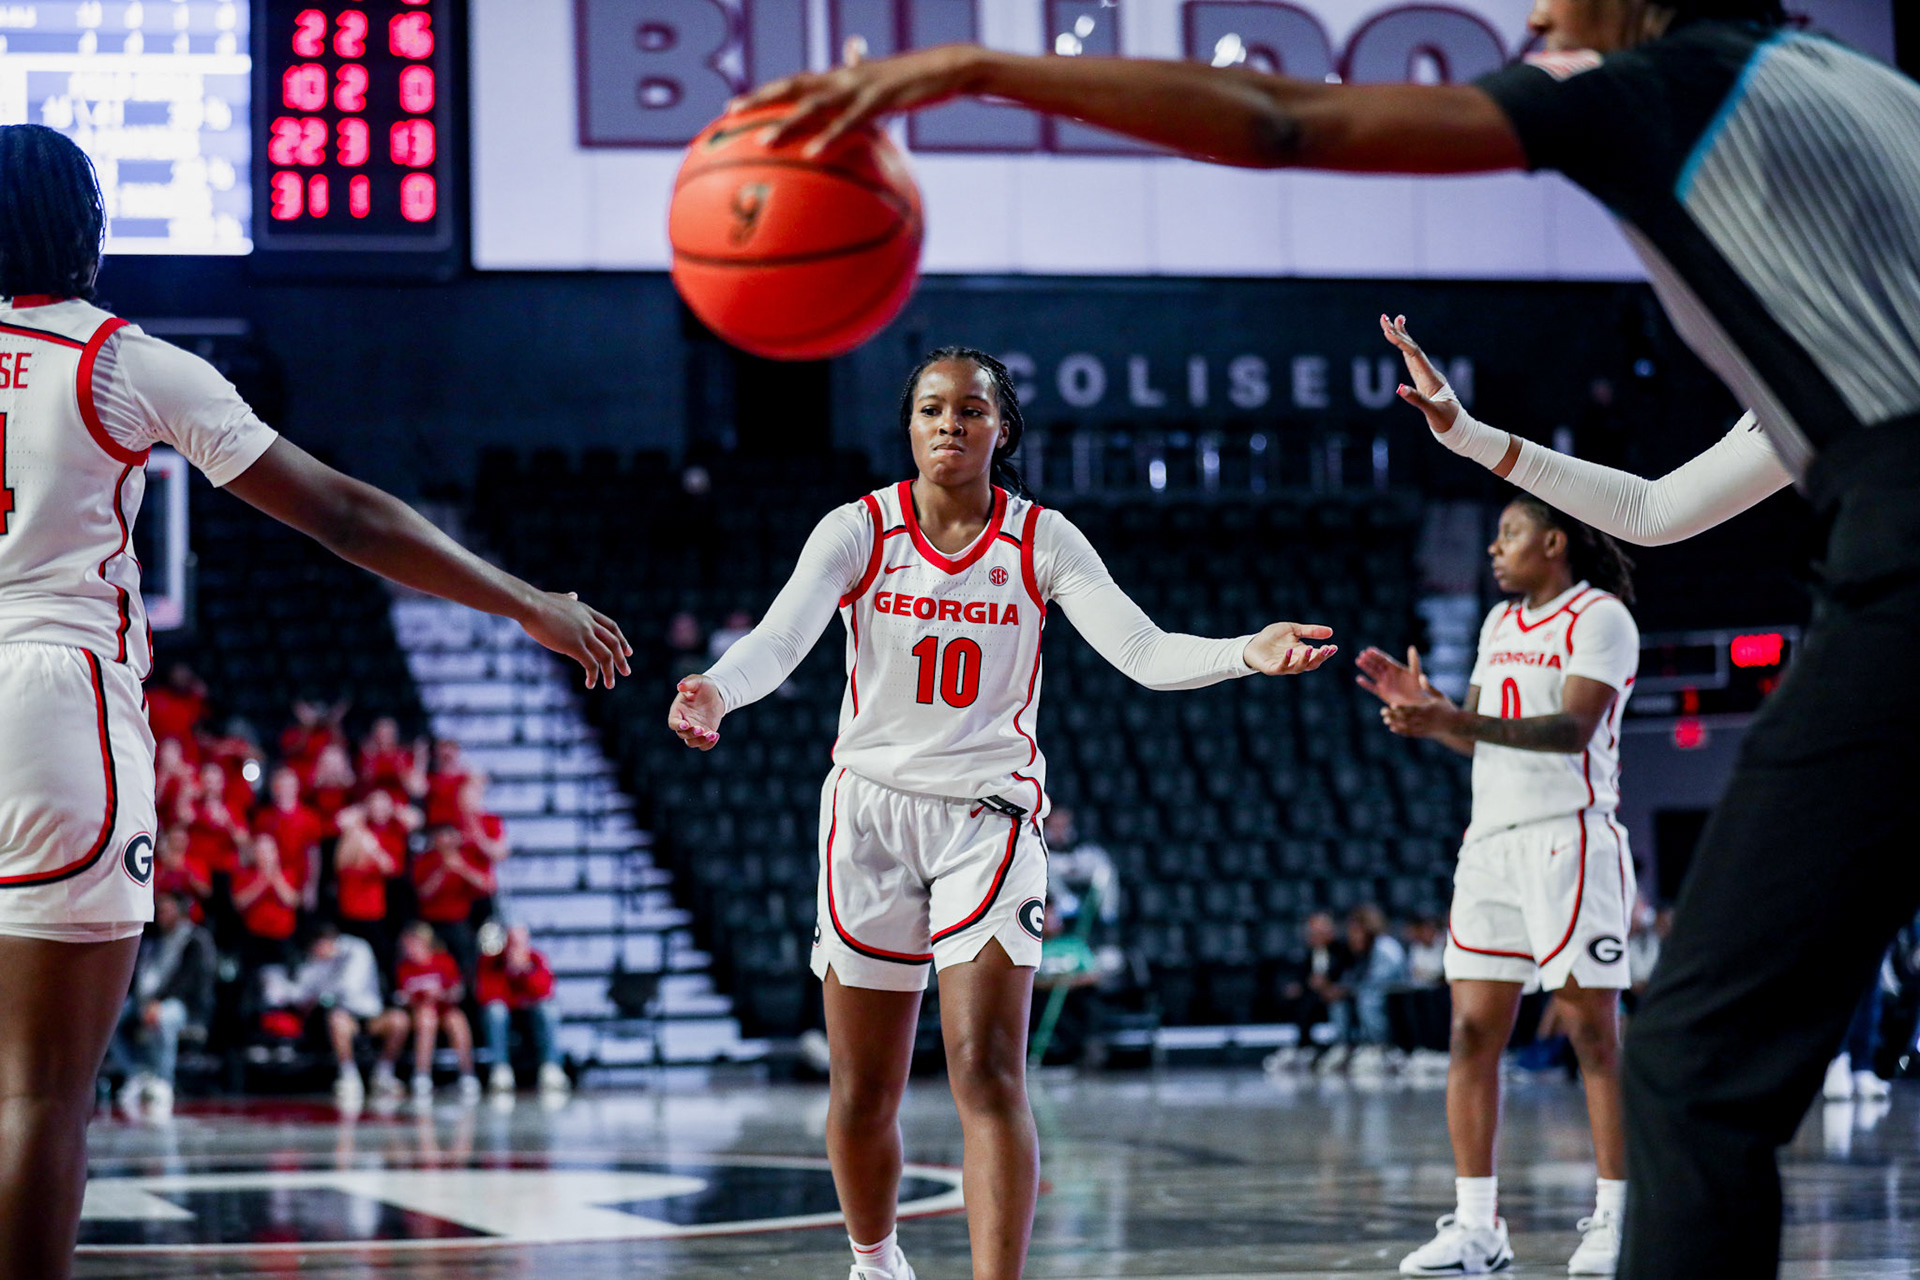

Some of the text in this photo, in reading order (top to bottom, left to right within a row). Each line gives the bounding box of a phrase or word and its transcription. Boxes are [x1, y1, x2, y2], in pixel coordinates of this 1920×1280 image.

[293, 9, 327, 57] 2
[333, 10, 368, 58] 2
[334, 63, 369, 112] 2
[268, 116, 328, 166] 22
[989, 567, 1008, 585] SEC
[874, 591, 1020, 626] GEORGIA
[911, 635, 983, 709] 10
[123, 834, 153, 884] G
[1588, 934, 1624, 965] G
